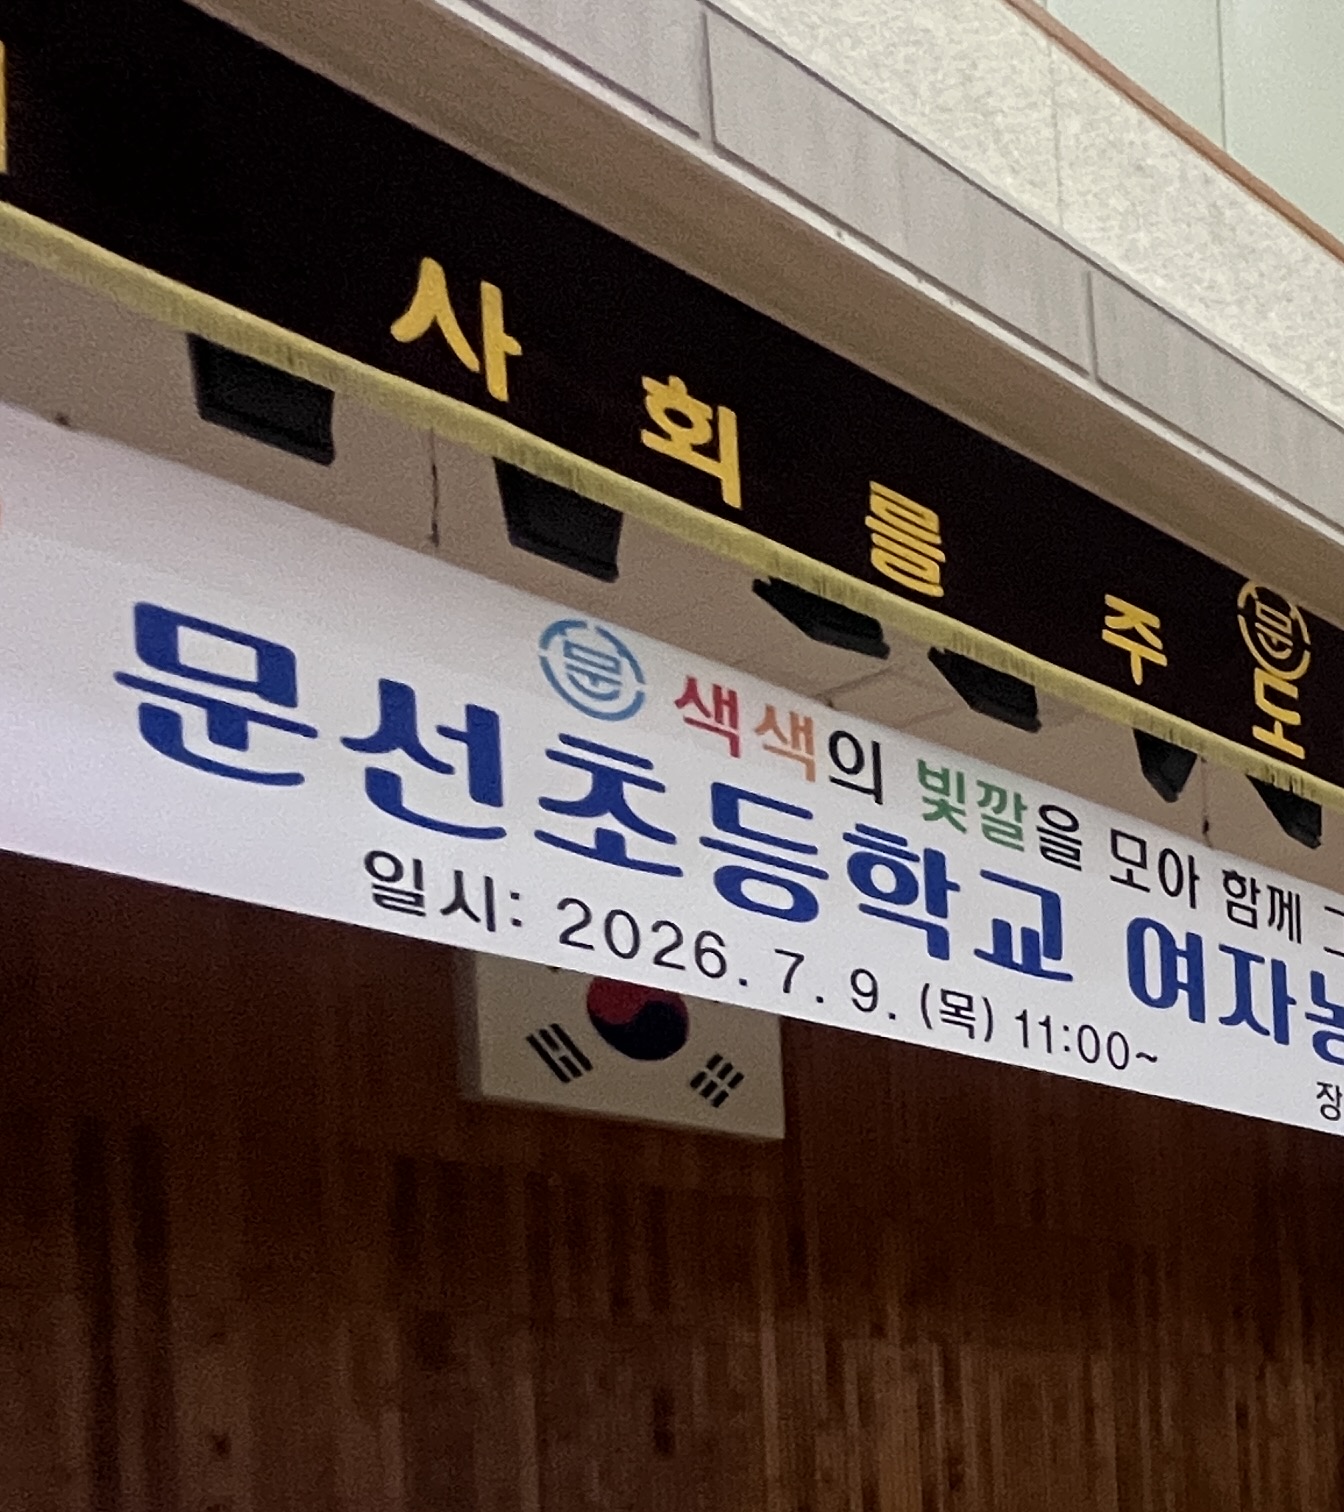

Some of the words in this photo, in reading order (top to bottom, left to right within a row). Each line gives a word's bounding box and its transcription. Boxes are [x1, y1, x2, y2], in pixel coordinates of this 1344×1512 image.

[113, 602, 1073, 983] 문선초등학교
[674, 675, 884, 804] 색색의
[917, 758, 1083, 871] 빛깔을
[1110, 828, 1200, 909] 모아
[1222, 868, 1302, 944] 함께
[364, 850, 522, 932] 일시:
[558, 898, 748, 986] 2026.
[921, 982, 994, 1043] (목)
[1015, 1009, 1158, 1071] 11:00~
